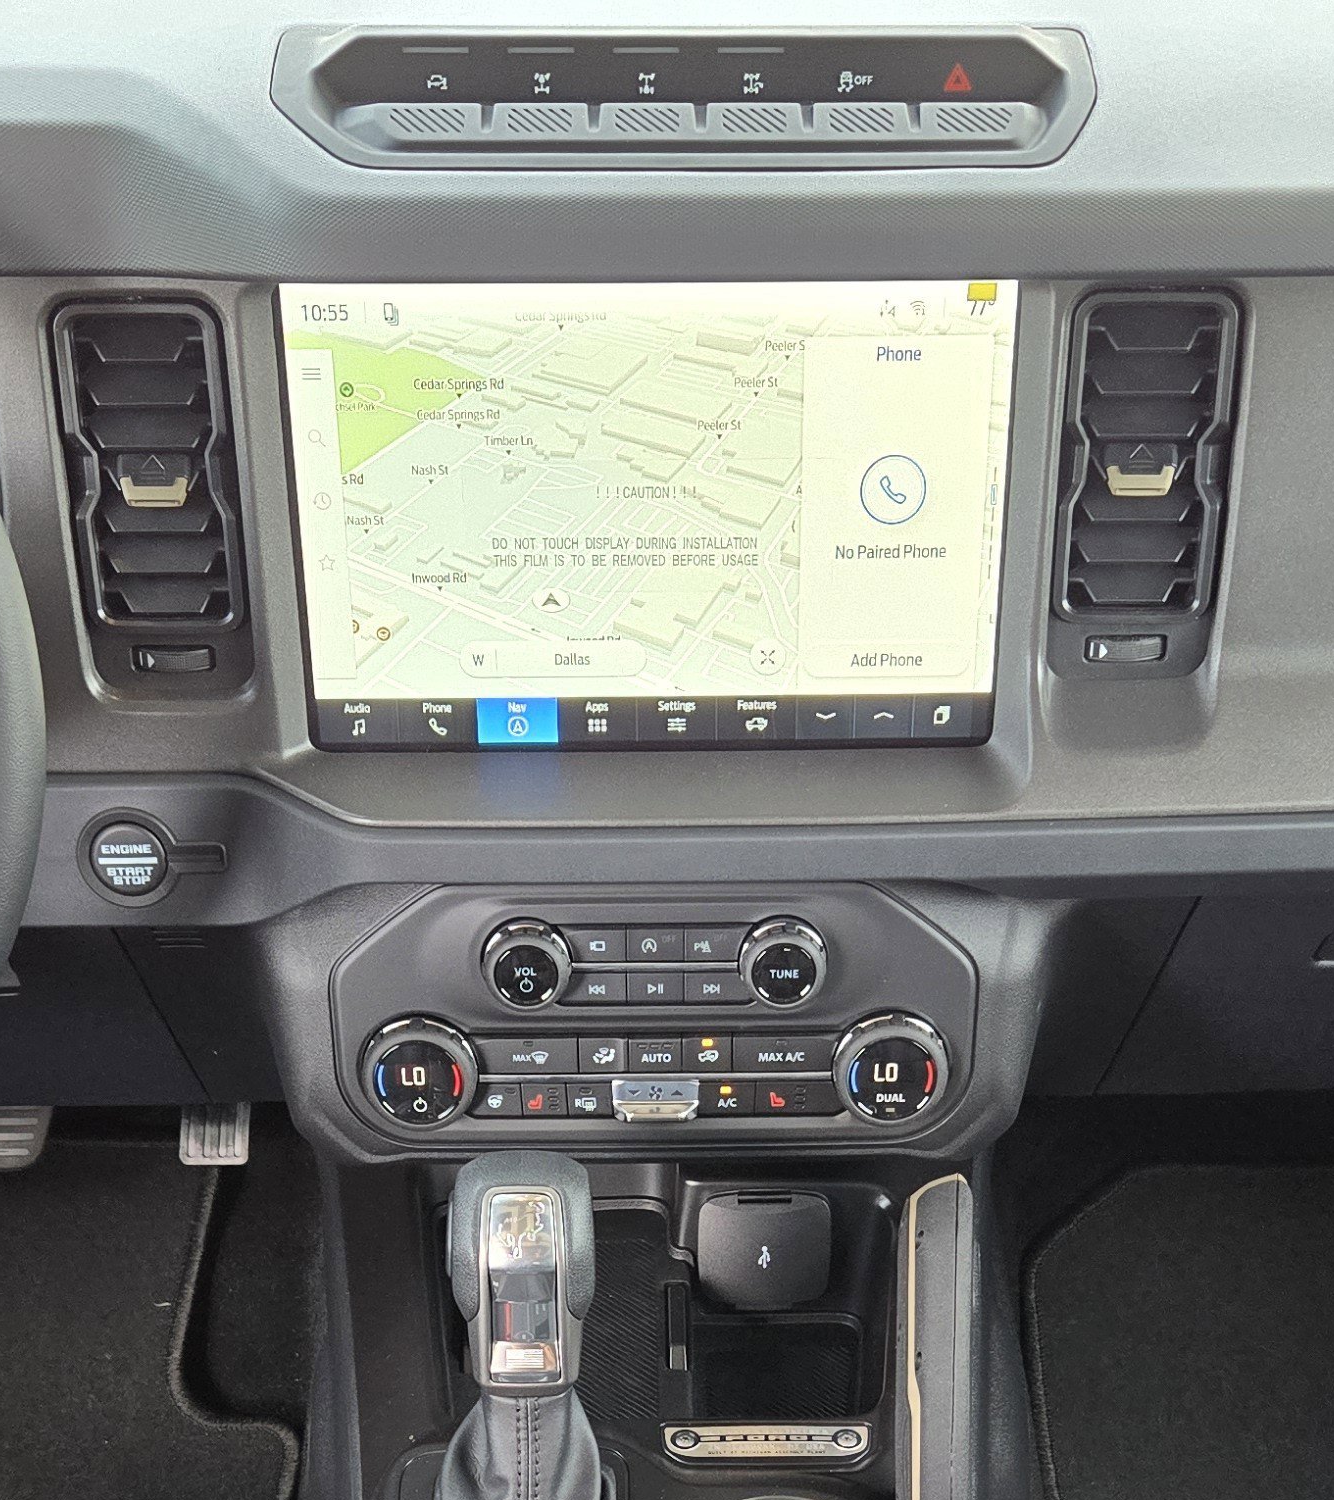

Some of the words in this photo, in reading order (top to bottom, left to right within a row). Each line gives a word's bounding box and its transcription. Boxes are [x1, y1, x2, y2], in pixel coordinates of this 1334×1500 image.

[854, 75, 873, 86] OFF
[301, 304, 348, 322] 10:55
[765, 340, 796, 351] Peeler
[876, 346, 921, 362] Phone
[413, 378, 445, 390] Cedar
[447, 378, 487, 392] Springs
[490, 378, 504, 390] Rd
[734, 377, 765, 388] Peeler
[767, 377, 778, 388] St
[417, 410, 445, 421] Cedar
[447, 410, 484, 422] Springs
[487, 409, 500, 420] Rd
[697, 419, 728, 431] Peeler
[731, 420, 742, 431] St
[484, 436, 518, 447] Timber
[521, 436, 533, 447] Ln
[411, 465, 436, 476] Nash
[439, 465, 449, 476] St
[349, 474, 364, 486] Rd
[346, 516, 371, 526] Nash
[374, 516, 384, 526] St
[492, 537, 508, 551] DO
[514, 537, 536, 551] NOT
[542, 537, 579, 551] TOUCH
[585, 537, 629, 551] DISPLAY
[635, 537, 676, 551] DURING
[682, 537, 758, 551] INSTALLATION
[835, 545, 854, 560] No
[857, 544, 900, 560] Paired
[903, 544, 947, 559] Phone
[493, 554, 517, 567] THIS
[523, 554, 548, 567] FILM
[554, 554, 564, 567] IS
[572, 554, 585, 567] TO
[592, 554, 607, 567] BE
[612, 554, 665, 567] REMOVED
[672, 554, 715, 567] BEFORE
[722, 554, 758, 567] USAGE
[411, 572, 450, 583] Inwood
[452, 572, 467, 583] Rd
[472, 655, 484, 666] W
[554, 653, 591, 666] Dallas
[850, 652, 877, 667] Add
[880, 652, 923, 667] Phone
[344, 702, 371, 714] Audio
[422, 702, 452, 713] Phone
[507, 702, 527, 713] Nav
[585, 701, 609, 714] Apps
[657, 700, 696, 713] Settings
[737, 700, 777, 711] Features
[101, 844, 152, 854] ENGINE
[106, 867, 154, 877] START
[113, 875, 151, 885] STOP
[513, 967, 537, 977] VOL
[769, 968, 799, 980] TUNE
[512, 1054, 532, 1063] MAX
[641, 1053, 672, 1063] AUTO
[758, 1053, 783, 1062] MAX
[785, 1052, 805, 1063] A/C
[401, 1067, 426, 1086] LO
[874, 1063, 899, 1083] LO
[718, 1098, 737, 1108] A/C
[876, 1093, 905, 1103] DUAL
